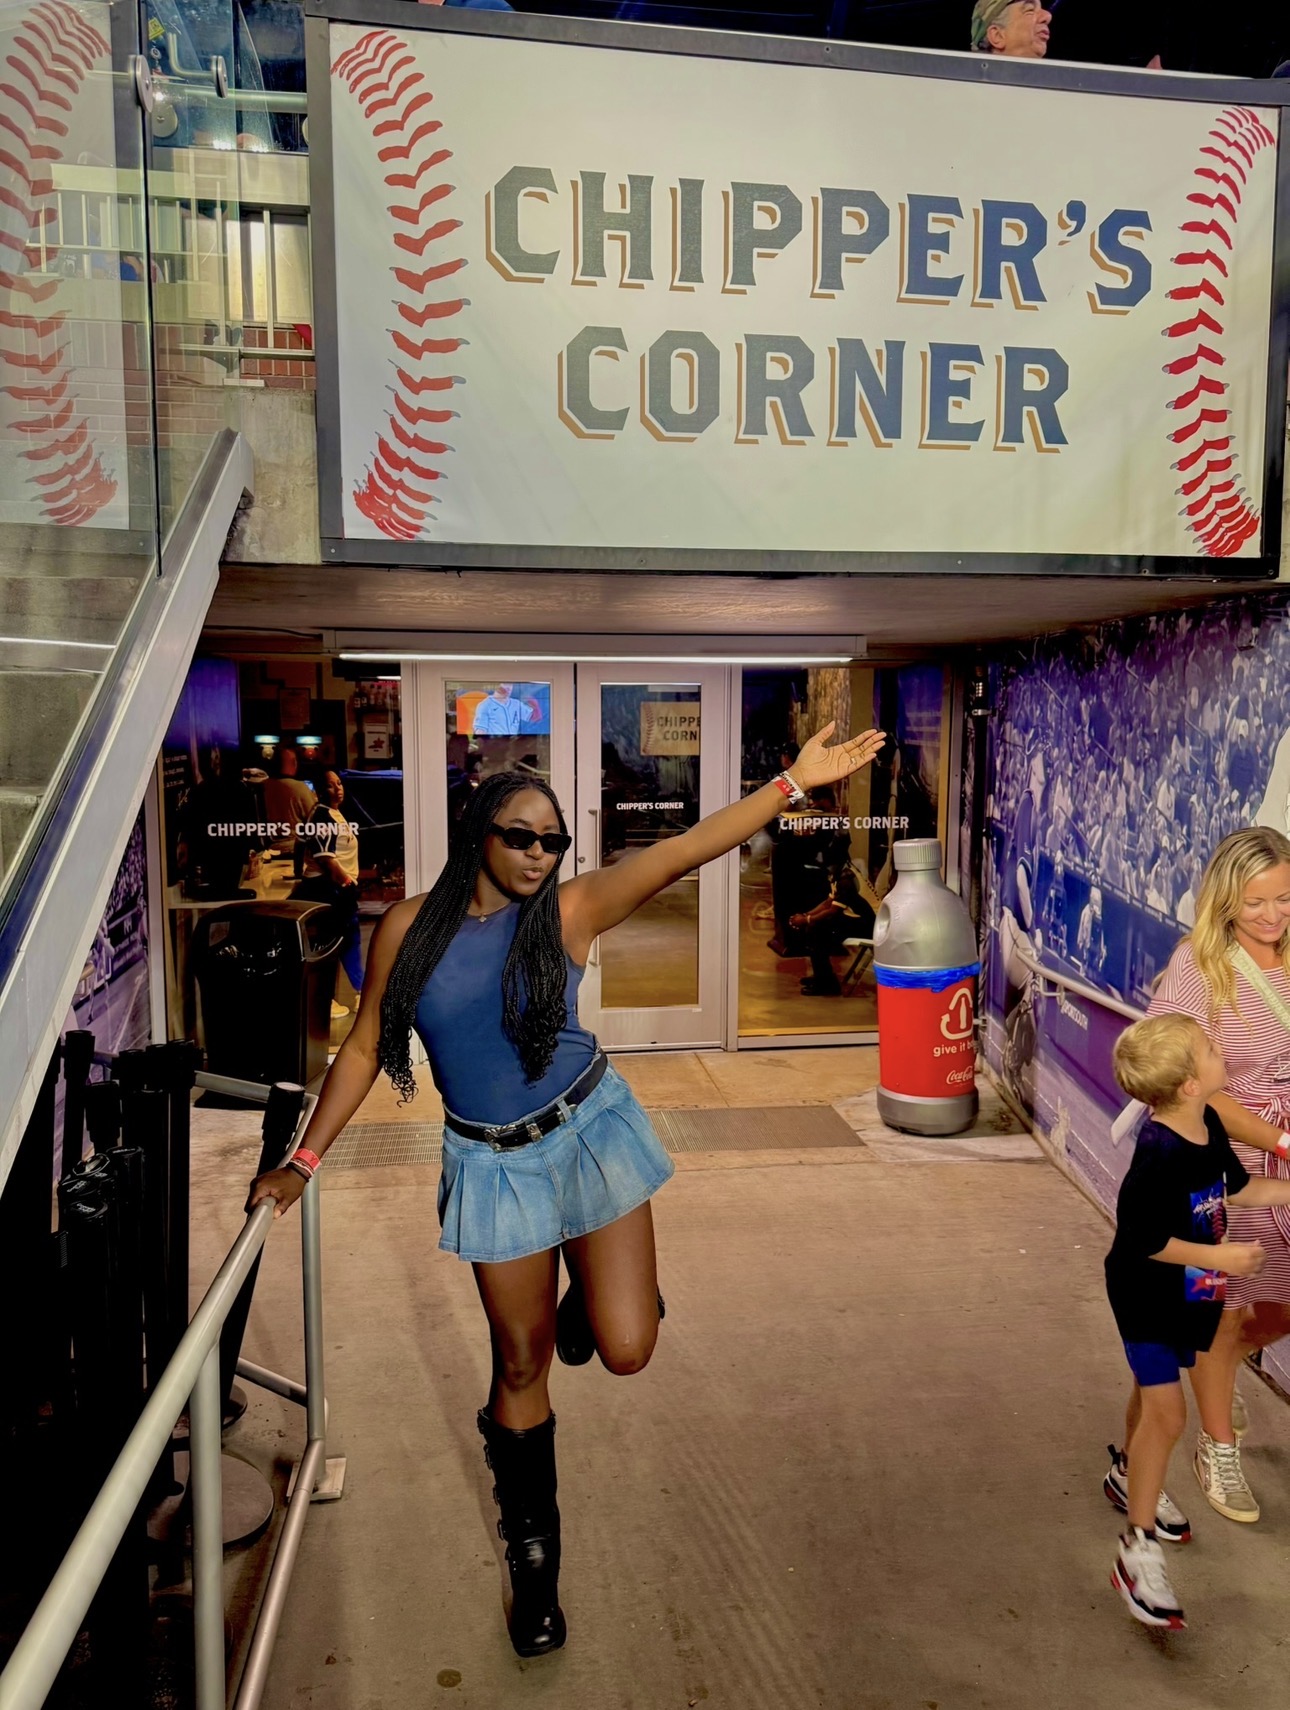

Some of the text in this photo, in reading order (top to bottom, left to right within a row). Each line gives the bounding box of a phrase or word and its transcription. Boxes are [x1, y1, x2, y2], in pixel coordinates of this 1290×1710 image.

[484, 165, 1153, 316] CHIPPER'S
[557, 324, 1069, 454] CORNER
[616, 801, 684, 811] CHIPPER'S CORNER
[207, 821, 359, 837] CHIPPER'S CORNER
[780, 815, 910, 830] CHIPPER'S CORNER
[933, 1044, 957, 1057] give
[960, 1041, 966, 1052] it
